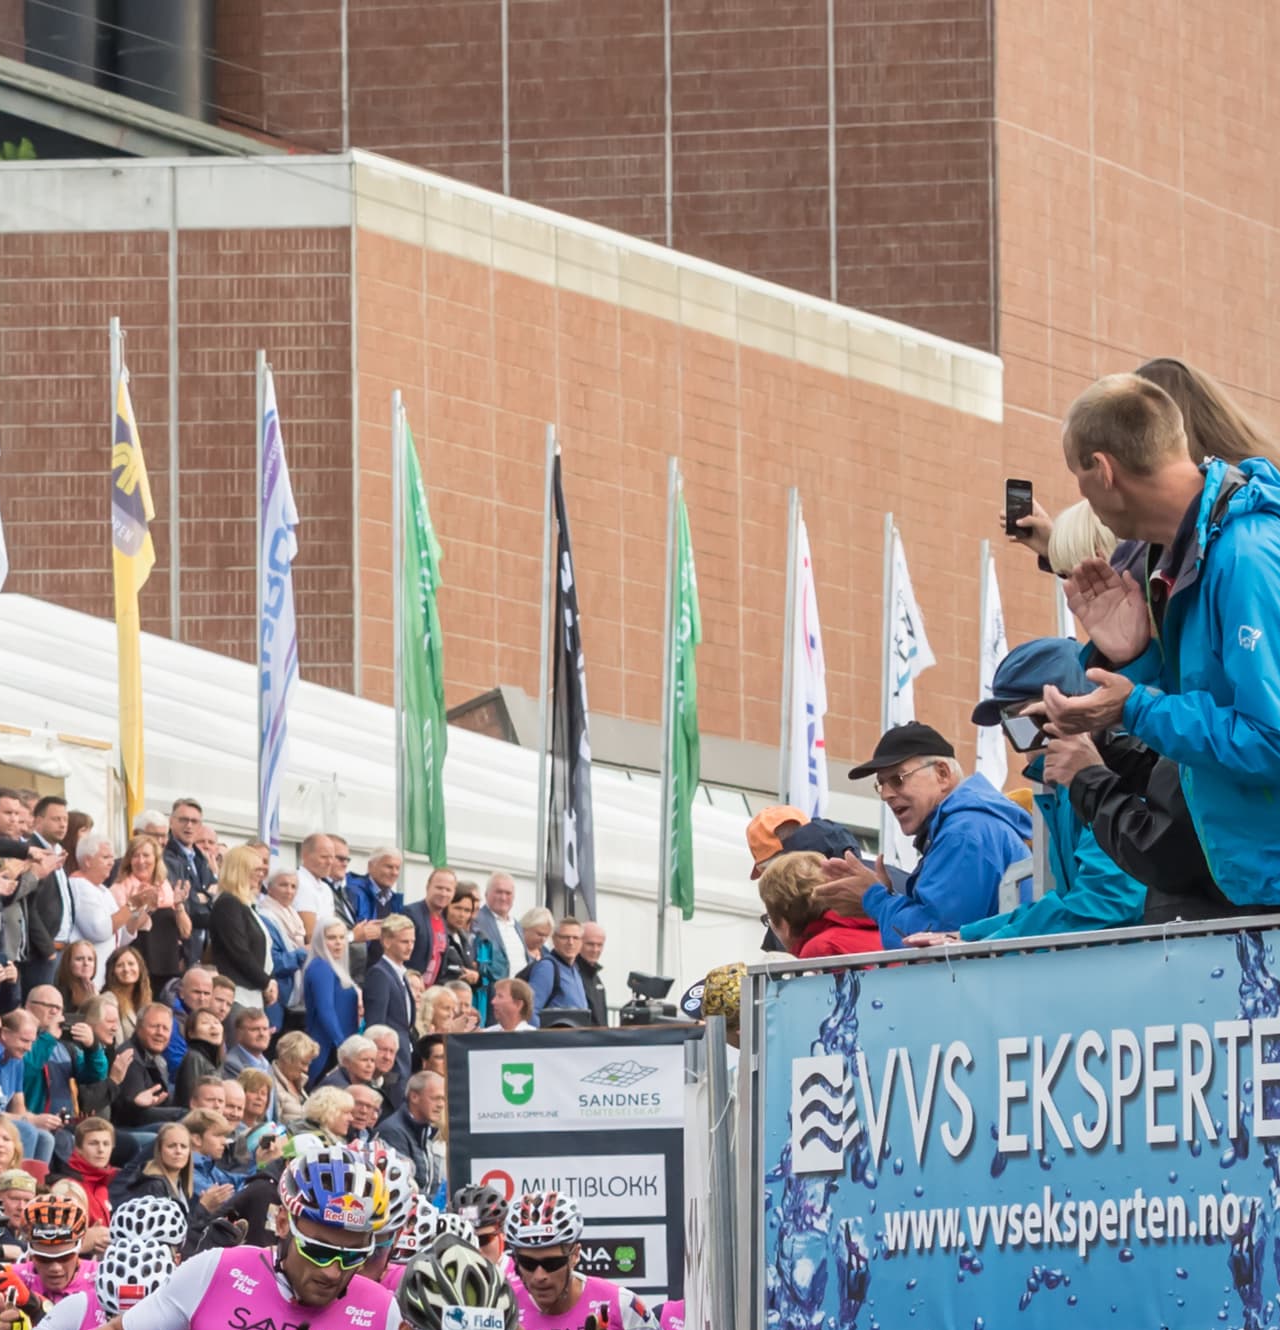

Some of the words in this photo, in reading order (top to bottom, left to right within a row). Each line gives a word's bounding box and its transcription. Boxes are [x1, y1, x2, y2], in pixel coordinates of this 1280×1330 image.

[579, 1093, 661, 1107] SANDNES
[857, 1041, 974, 1167] VVS
[324, 1208, 344, 1222] Red
[346, 1212, 366, 1225] Bull
[884, 1187, 1241, 1256] www.vvseksperten.no
[232, 1279, 253, 1296] Hus
[350, 1316, 372, 1327] Hus
